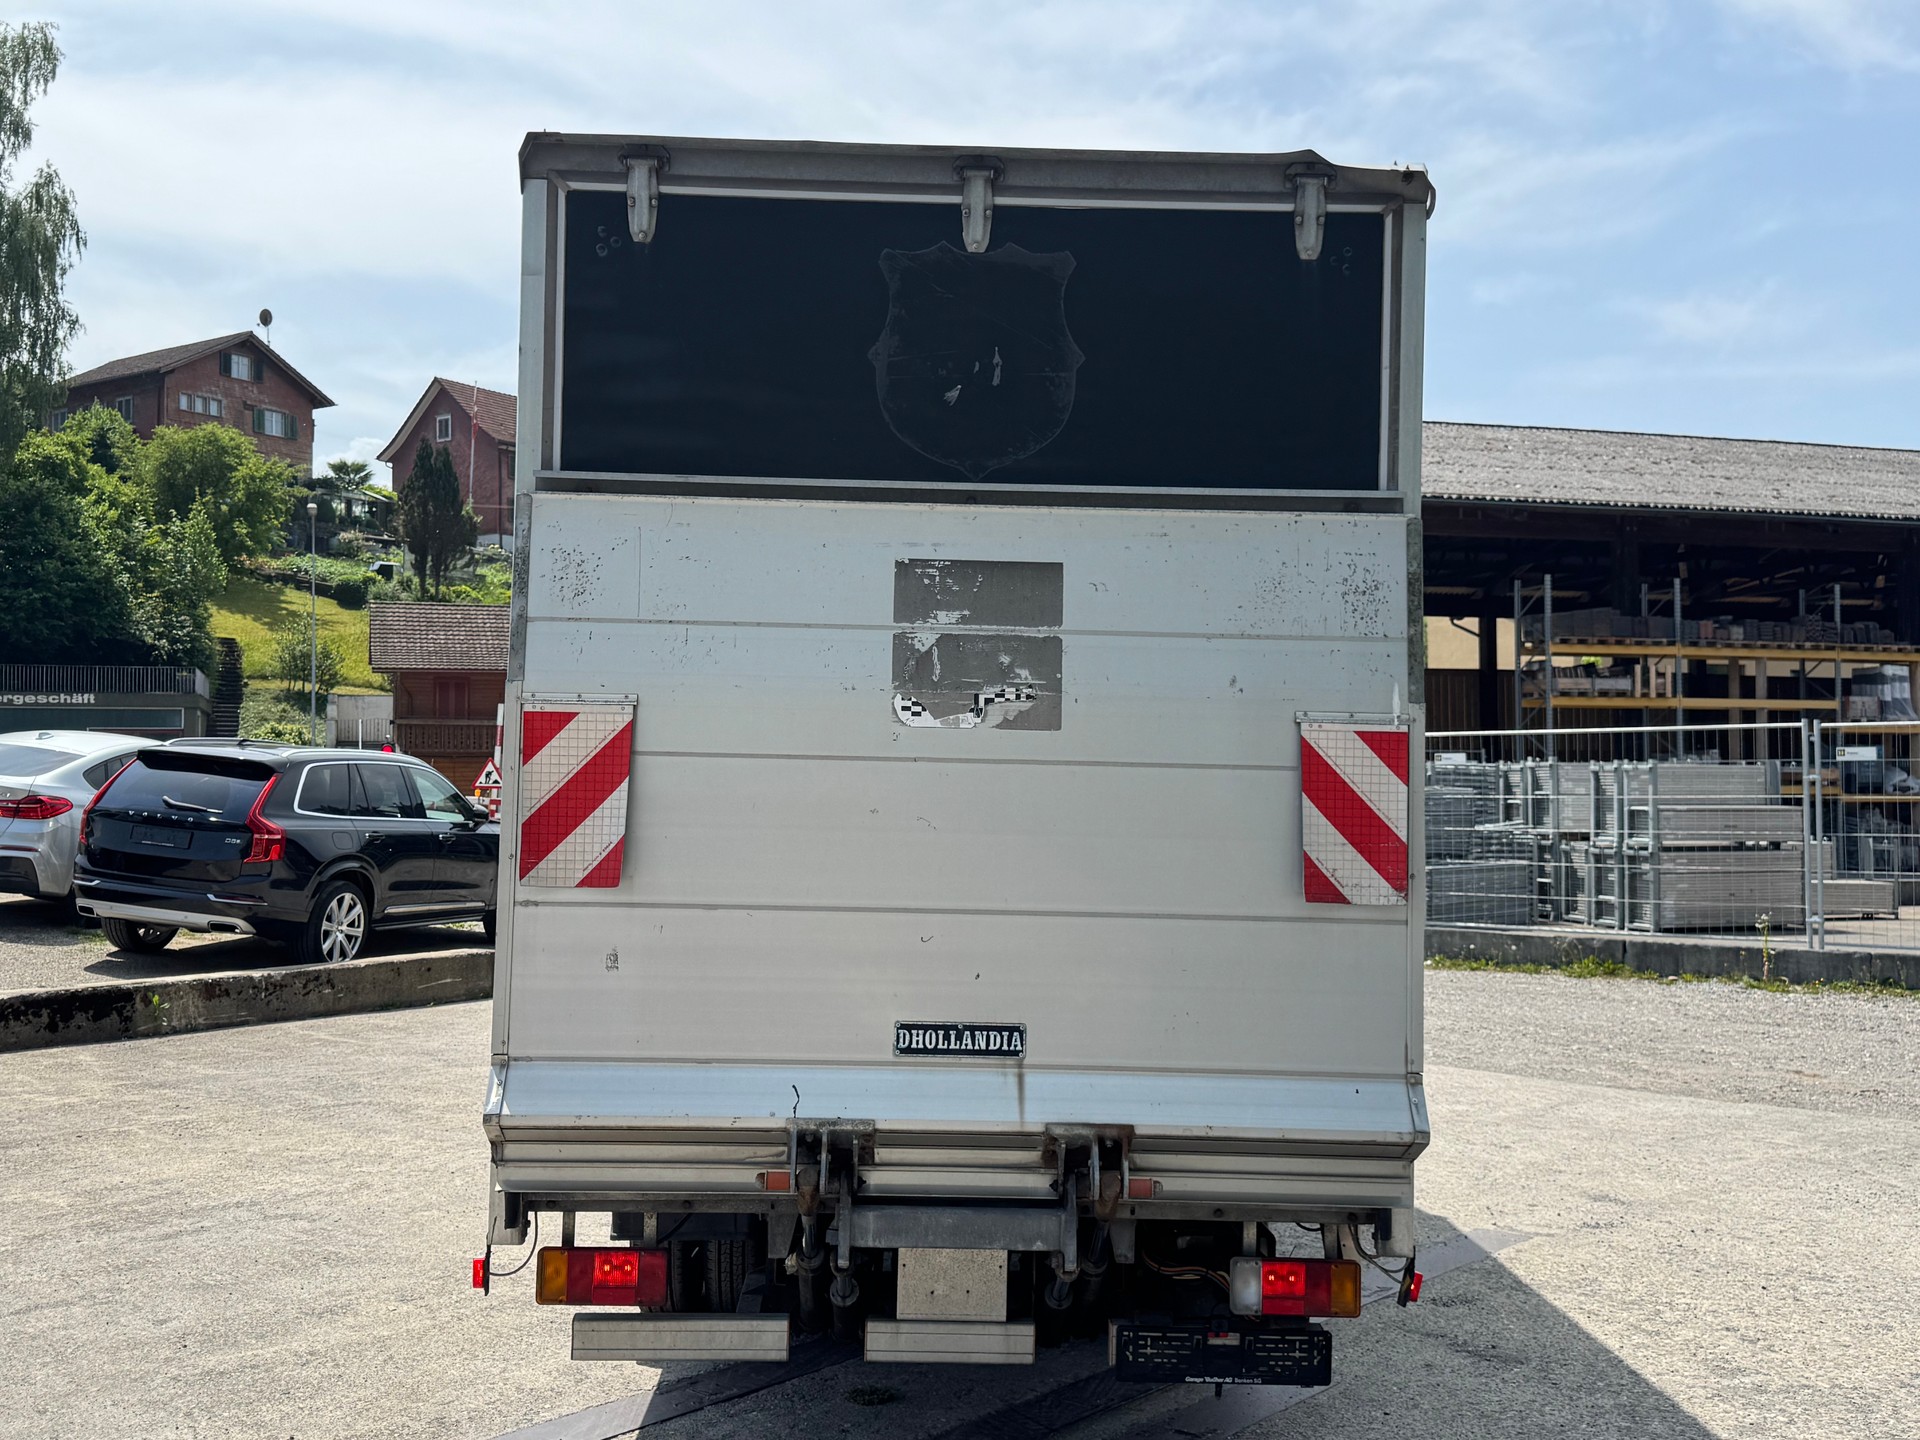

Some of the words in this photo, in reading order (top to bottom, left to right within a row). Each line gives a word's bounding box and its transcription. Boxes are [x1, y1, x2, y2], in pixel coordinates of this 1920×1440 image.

[0, 693, 96, 705] rgeschäft
[128, 810, 194, 822] VOLVO
[897, 1029, 1023, 1051] DHOLLANDIA
